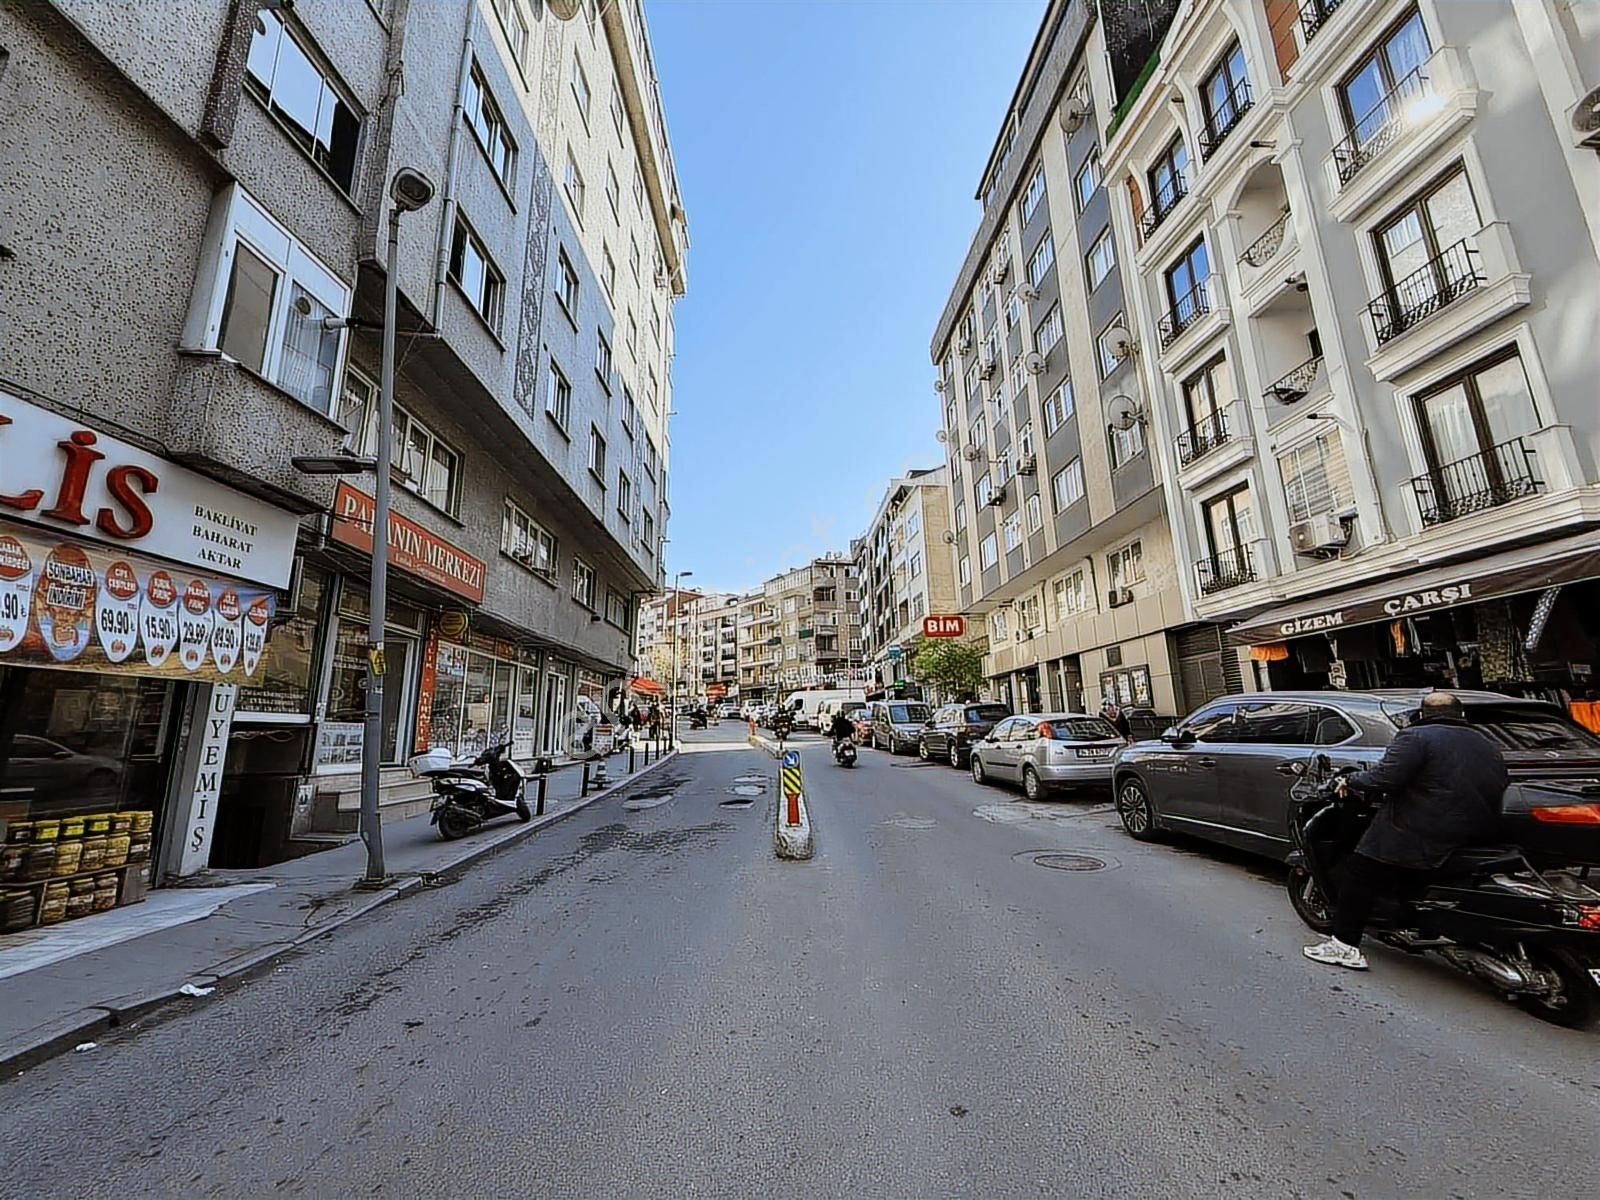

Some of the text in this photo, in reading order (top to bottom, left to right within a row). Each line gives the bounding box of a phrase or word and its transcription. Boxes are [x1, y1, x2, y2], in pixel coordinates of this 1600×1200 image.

[194, 504, 258, 537] BAKLİYAT
[192, 525, 254, 553] BAHARAT
[197, 547, 242, 570] AKTAR
[424, 540, 481, 588] MERKEZİ
[47, 561, 94, 586] SONBAHAR
[101, 608, 129, 635] 69.90
[1280, 584, 1473, 635] GİZEM ÇARŞI
[145, 615, 171, 640] 15.90
[927, 615, 961, 633] BİM
[191, 682, 233, 852] UYEMİŞ
